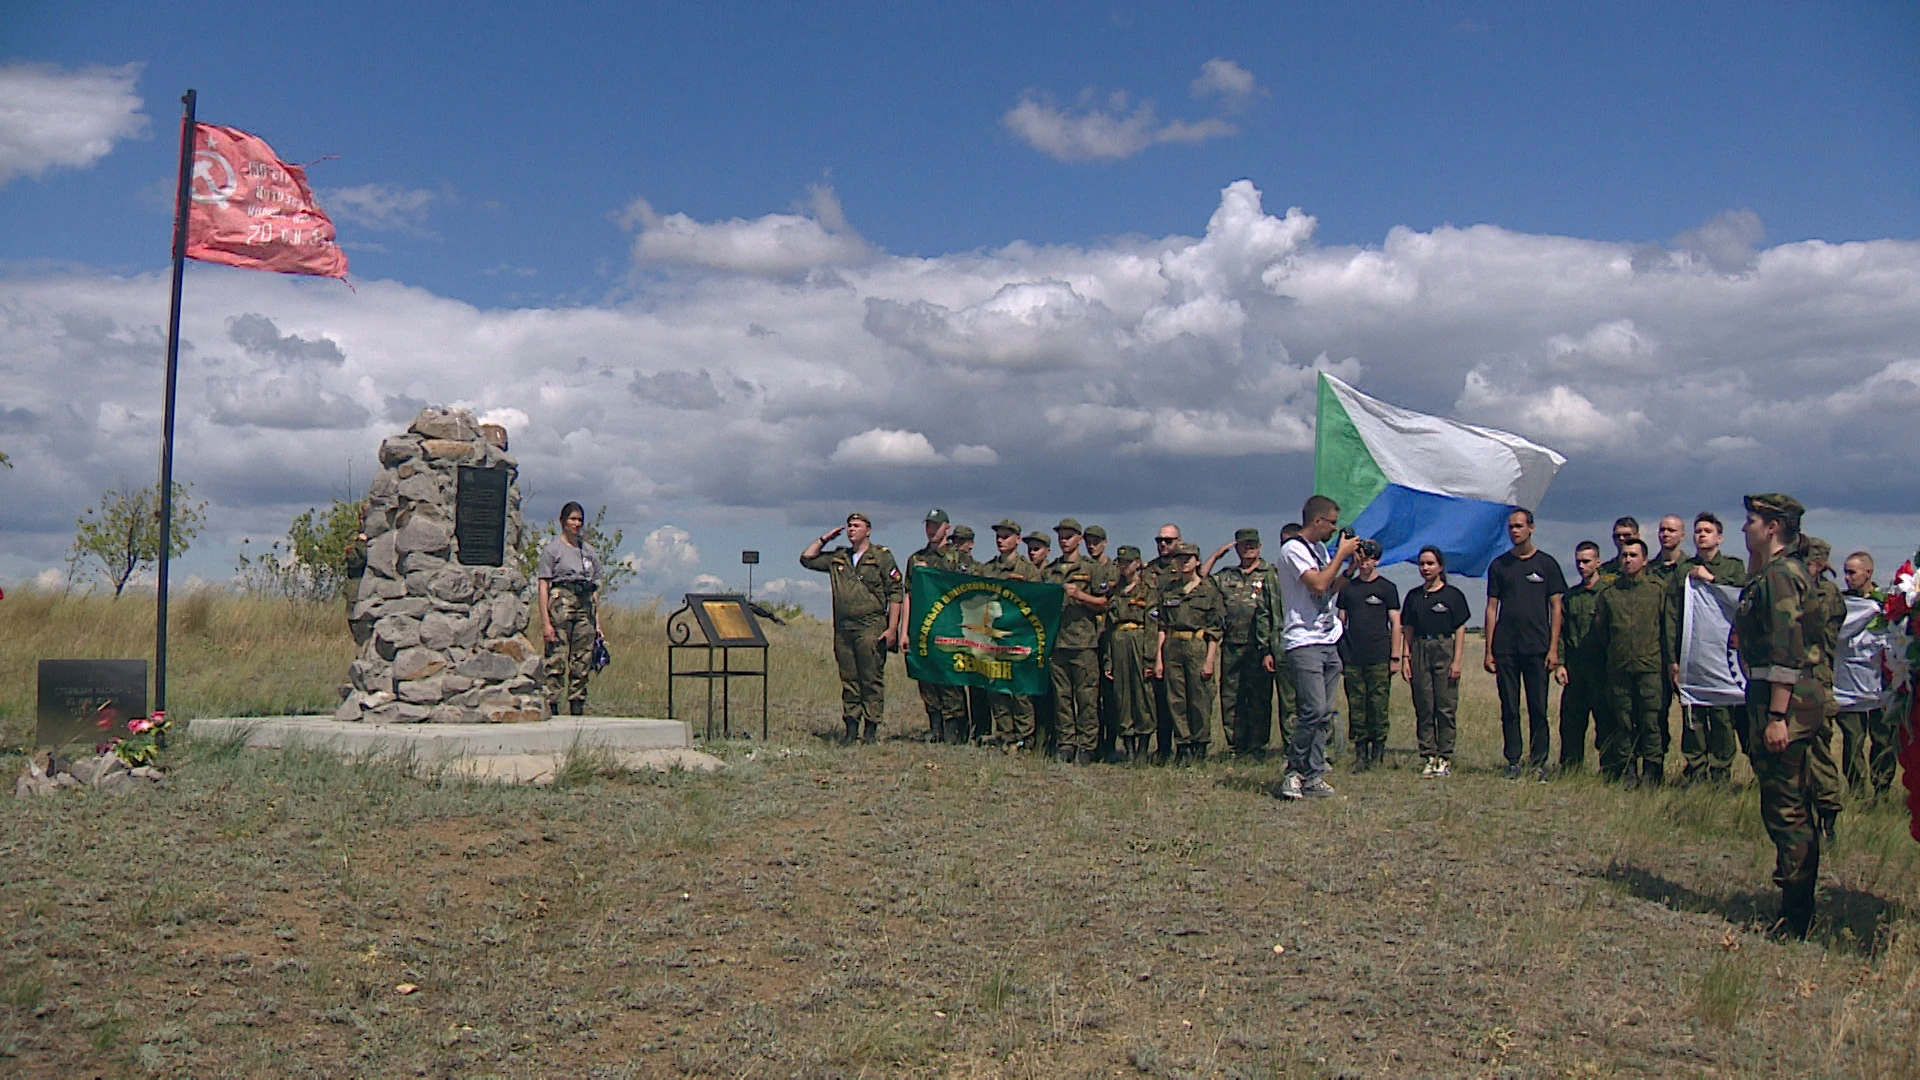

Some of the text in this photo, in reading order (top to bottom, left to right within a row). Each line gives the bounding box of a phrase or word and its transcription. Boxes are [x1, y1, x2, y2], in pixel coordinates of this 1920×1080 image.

[919, 601, 945, 657] СВОДНЫЙ
[941, 581, 1003, 604] ПОИСКОВЫЙ
[1002, 589, 1032, 616] ОТРЯД
[953, 653, 1013, 680] ЗЕМЛЯК
